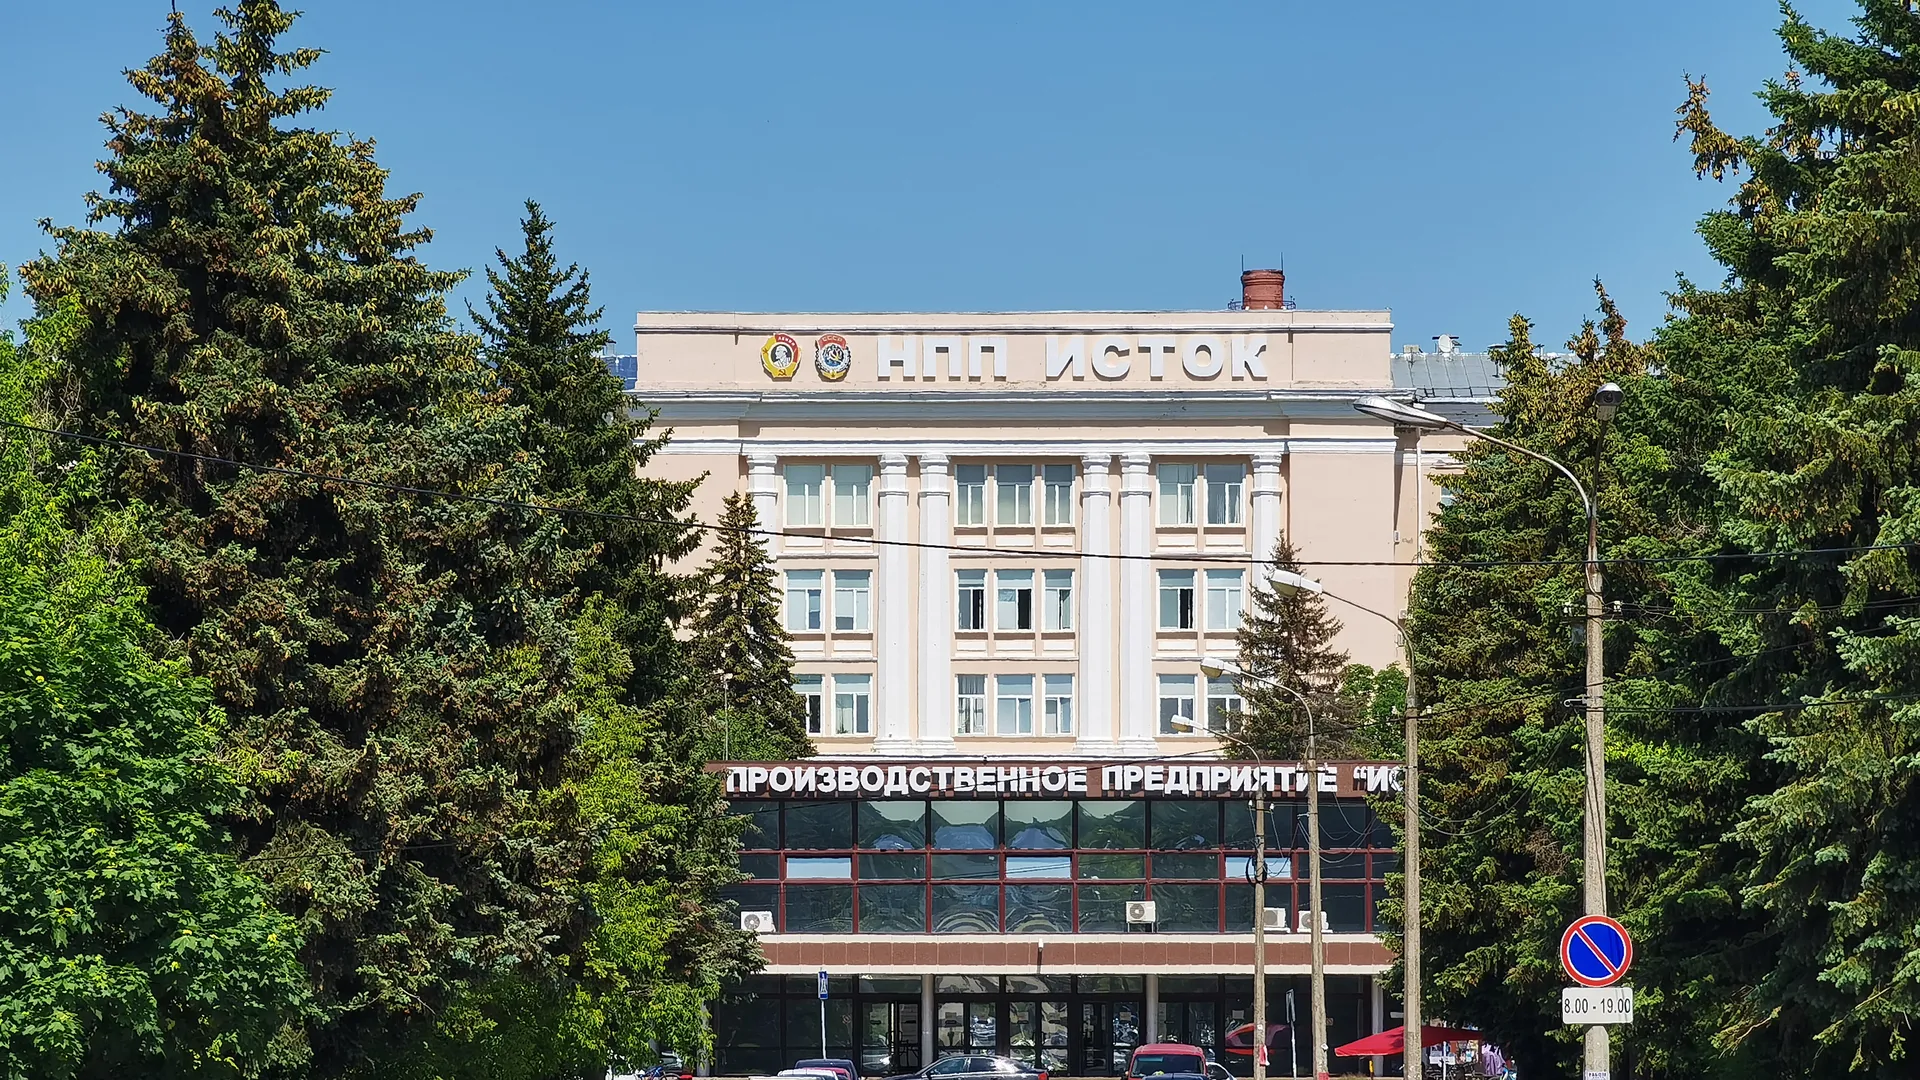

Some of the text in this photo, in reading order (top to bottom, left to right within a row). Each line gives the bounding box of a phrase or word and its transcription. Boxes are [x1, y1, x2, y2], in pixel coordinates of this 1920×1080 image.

[877, 336, 1268, 378] НПП ИСТОК
[726, 765, 1088, 796] ПРОИЗВОДСТВЕННОЕ
[1101, 765, 1338, 794] ПРЕДПРИЯТИЕ
[1564, 998, 1588, 1014] 8.00
[1600, 998, 1631, 1014] 19.00
